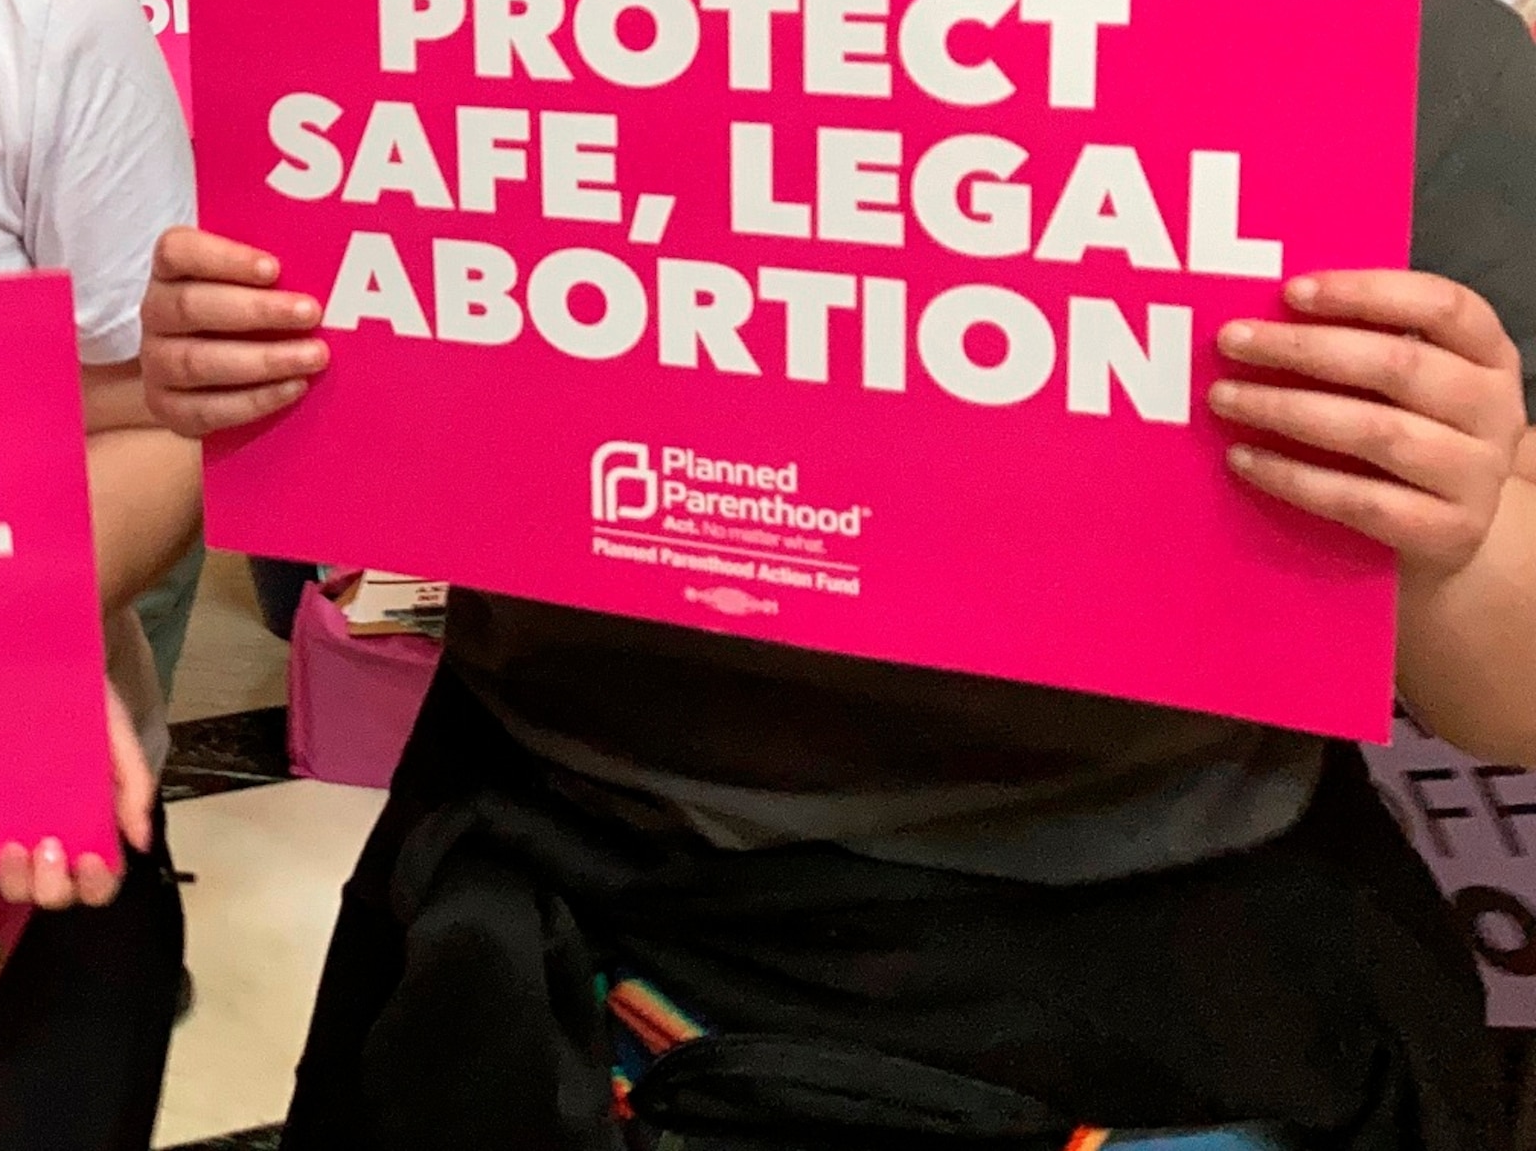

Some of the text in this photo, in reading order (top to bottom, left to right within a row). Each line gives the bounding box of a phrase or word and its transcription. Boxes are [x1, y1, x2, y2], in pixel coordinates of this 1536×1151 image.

[265, 91, 1284, 280] SAFE, LEGAL
[320, 230, 1193, 425] ABORTION
[662, 446, 798, 494] Planned
[662, 480, 861, 537] Parenthood
